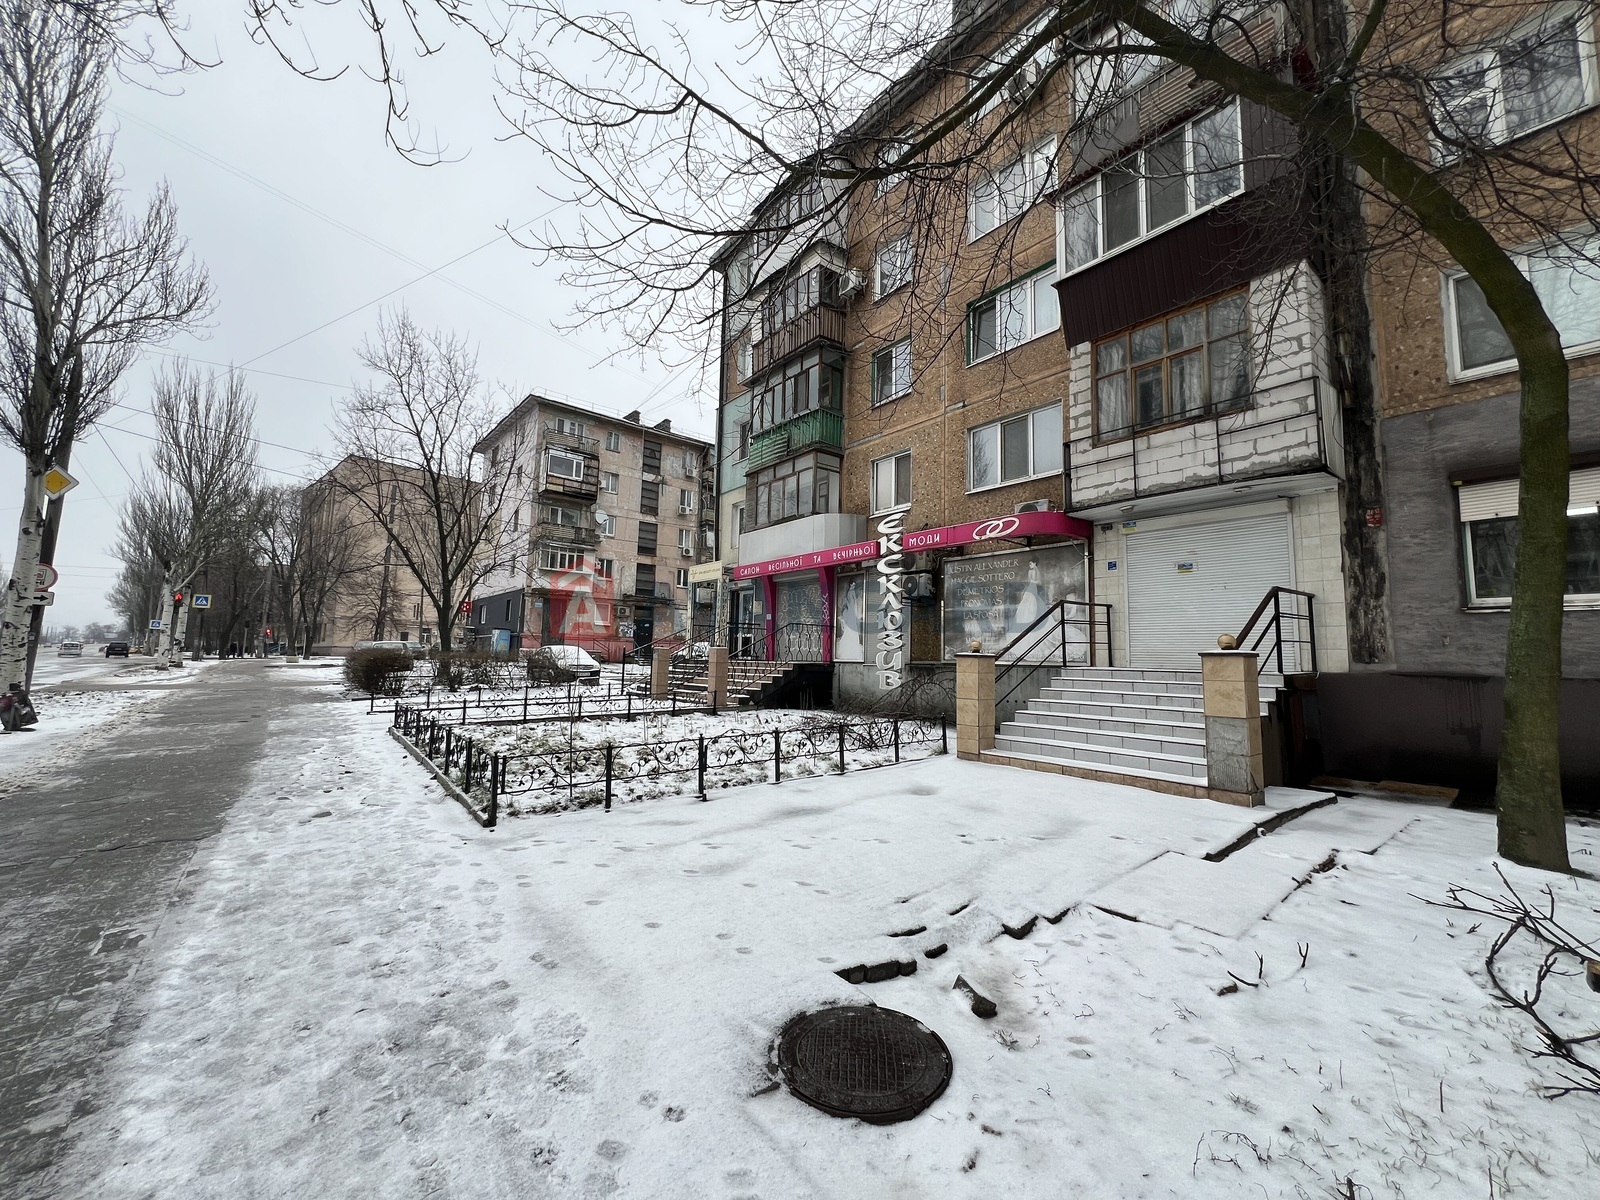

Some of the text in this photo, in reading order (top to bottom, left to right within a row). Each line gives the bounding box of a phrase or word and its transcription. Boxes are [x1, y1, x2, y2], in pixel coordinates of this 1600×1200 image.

[740, 533, 940, 576] САЛОН ВЕСІЛЬНОЇ ТА ВЕЧІРНЬОЇ МОДИ
[974, 558, 1019, 571] ALEXANDER
[978, 571, 1016, 583] SOTTERO
[957, 584, 1005, 596] DEMETRIOS
